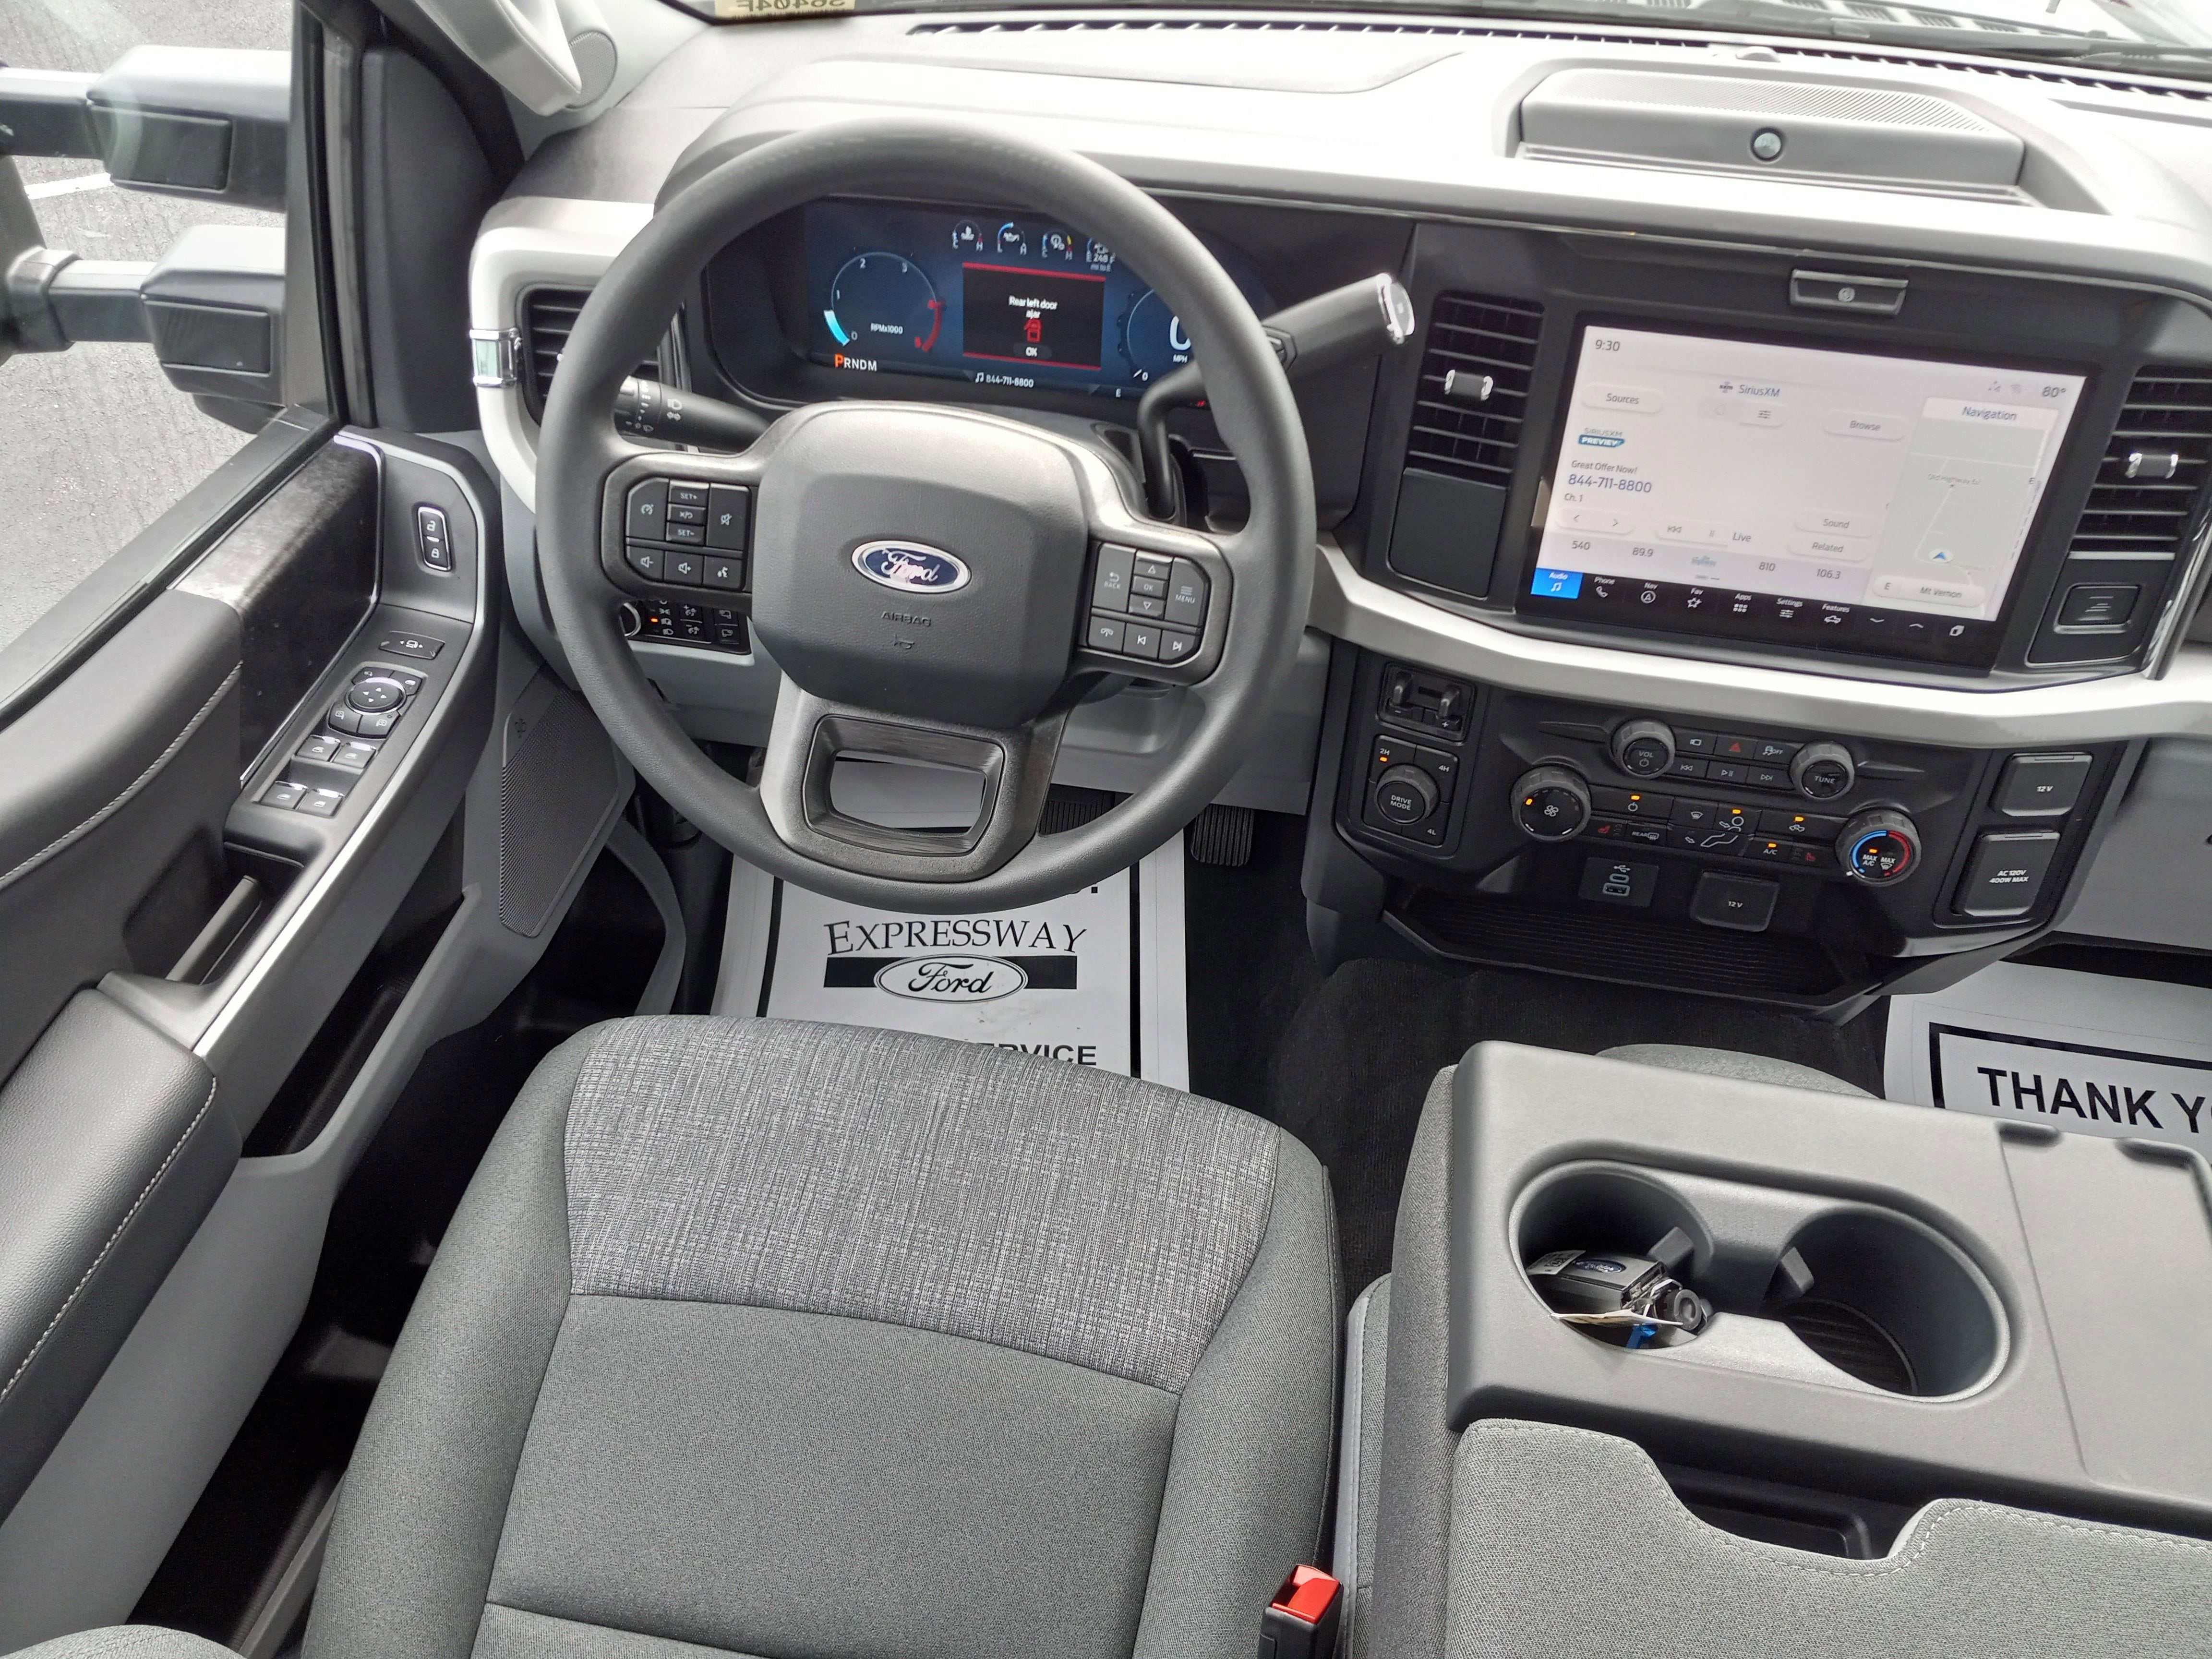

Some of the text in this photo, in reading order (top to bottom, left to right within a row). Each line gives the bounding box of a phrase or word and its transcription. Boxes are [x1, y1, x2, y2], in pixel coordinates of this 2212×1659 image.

[860, 258, 866, 269] 2
[1009, 295, 1058, 310] Rear left door
[1026, 309, 1041, 320] ajar
[851, 331, 858, 340] 0
[1595, 340, 1621, 351] 9:30
[1026, 347, 1038, 357] OK
[1172, 354, 1189, 363] MPH
[986, 374, 1034, 388] 844-711-8800
[1142, 372, 1148, 381] 0
[1116, 388, 1121, 397] E
[1738, 385, 1780, 397] SiriusXM
[1606, 393, 1639, 405] Sources
[1961, 406, 2017, 421] Navigation
[1850, 420, 1881, 431] Browse
[1571, 460, 1638, 474] Great Offer Now!
[1568, 474, 1652, 493] 844-711-8800
[1564, 493, 1584, 502] Ch. 1
[1823, 518, 1850, 529] Sound
[1733, 532, 1752, 543] Live
[1572, 540, 1591, 551] 540
[1812, 542, 1844, 553] Related
[1632, 547, 1654, 557] 89.9
[880, 548, 940, 583] Ford
[1759, 562, 1776, 571] 810
[1549, 572, 1568, 580] Audio
[1816, 568, 1841, 579] 106.3
[1104, 581, 1120, 590] BACK
[1594, 577, 1615, 585] Phone
[1885, 582, 1890, 590] E
[1734, 593, 1752, 601] Apps
[1920, 587, 1962, 598] Mt Vernon
[1175, 594, 1195, 604] MENU
[1776, 598, 1803, 608] Settings
[1822, 603, 1850, 613] Features
[881, 611, 931, 627] AIRBAG
[1815, 775, 1836, 784] TUNE
[1391, 794, 1412, 805] DRIVE
[1390, 800, 1411, 811] MODE
[823, 918, 1088, 956] EXPRESSWAY
[908, 962, 994, 993] Ford
[1977, 1066, 2212, 1134] THANK Y
